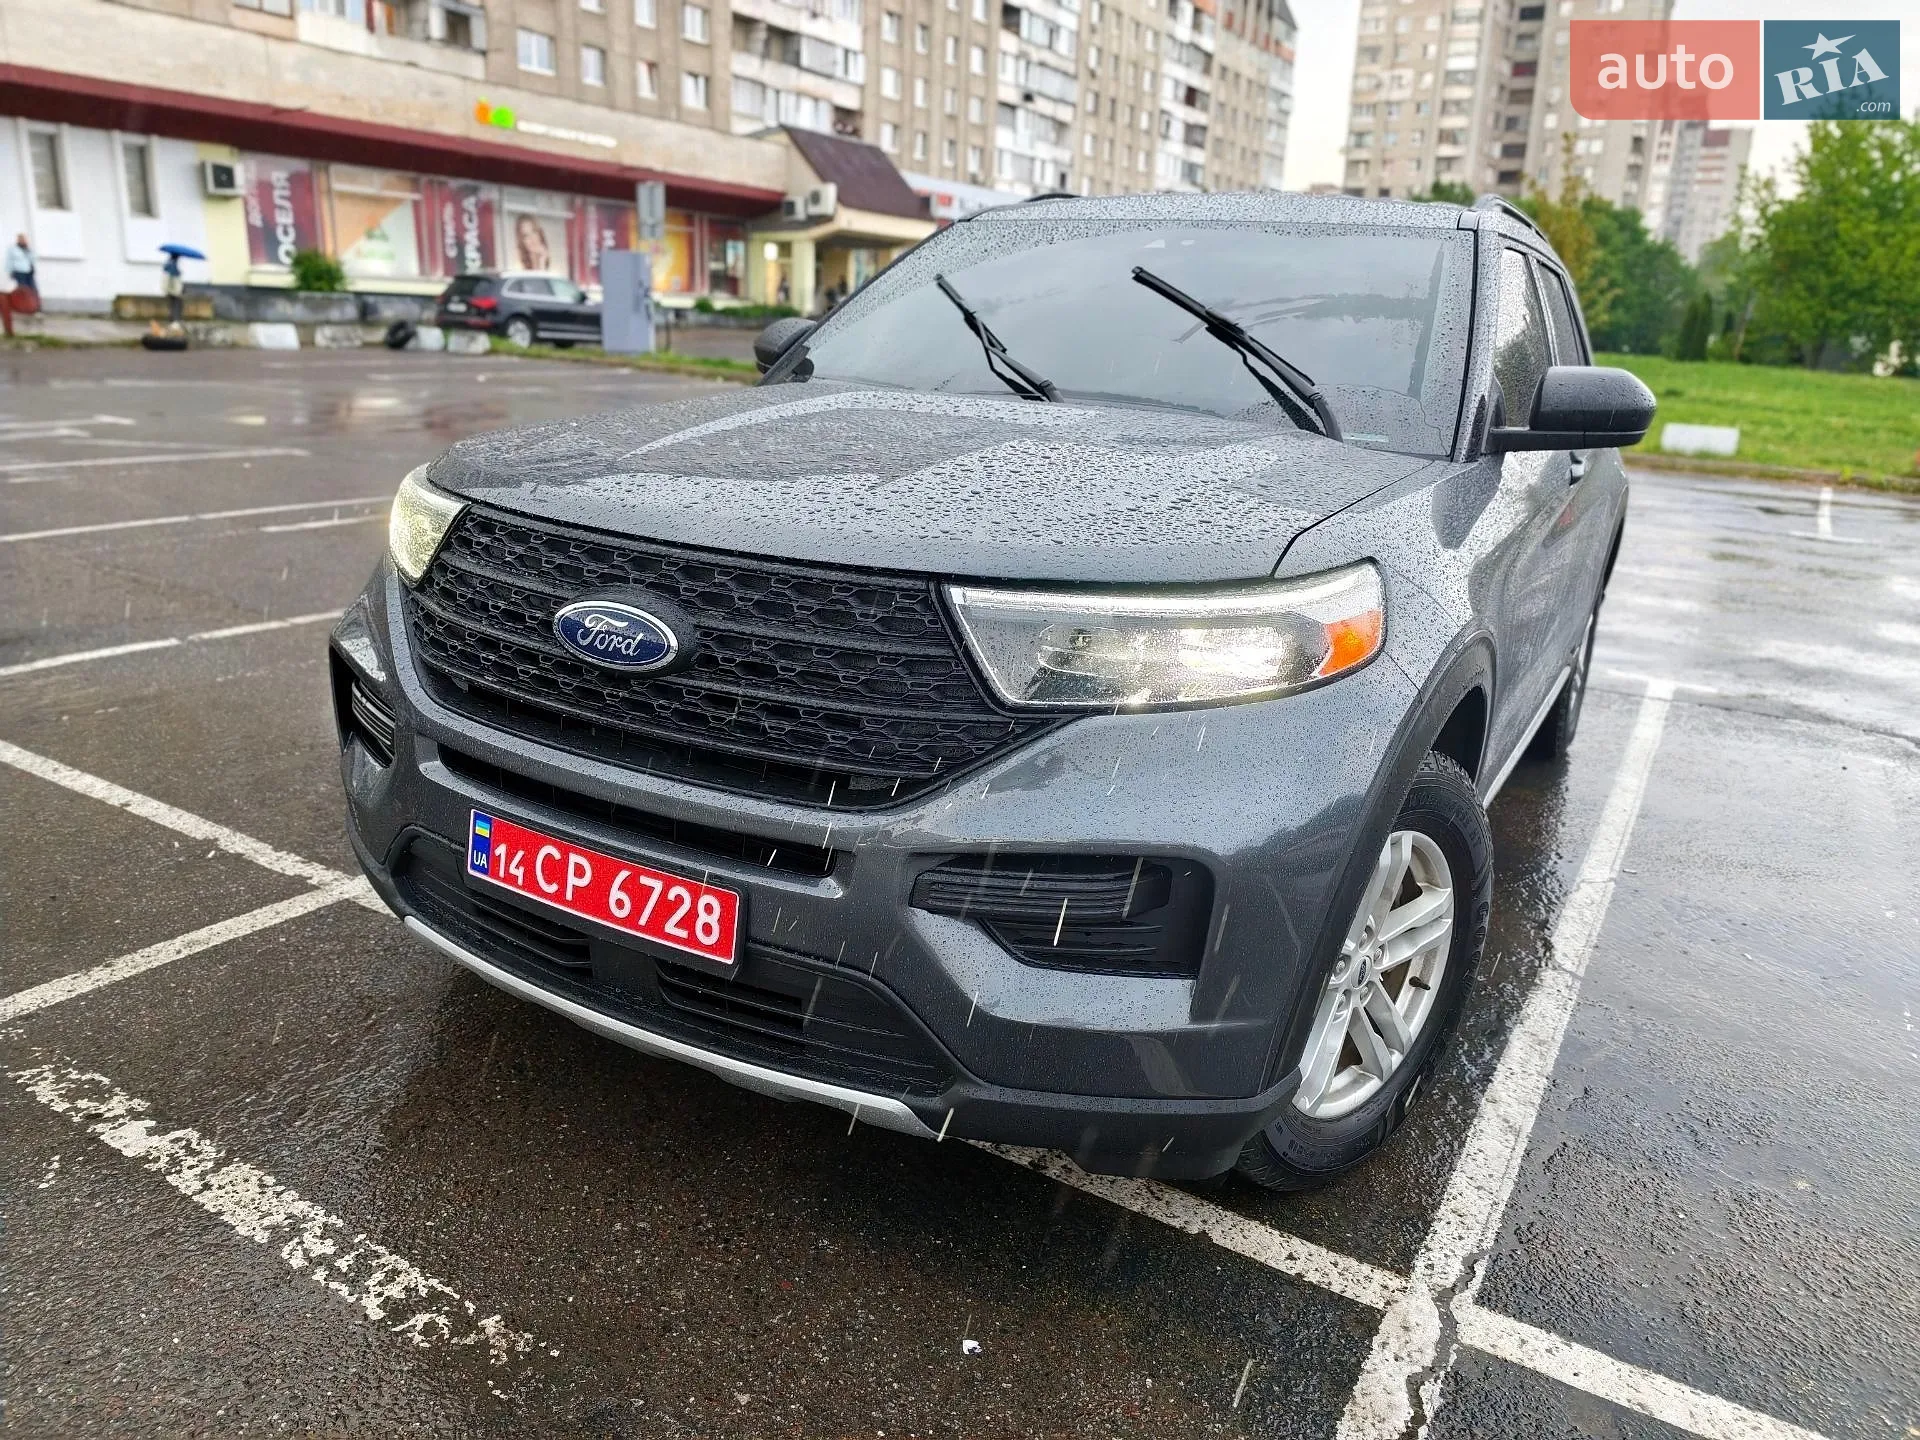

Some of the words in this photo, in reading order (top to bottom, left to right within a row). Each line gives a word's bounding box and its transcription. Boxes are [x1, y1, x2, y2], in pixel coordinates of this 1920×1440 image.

[271, 170, 297, 265] ОСЕЛЯ
[577, 613, 645, 657] Ford
[473, 849, 488, 869] UA
[494, 843, 525, 886] 14
[535, 845, 592, 902] CP
[608, 869, 721, 946] 6728
